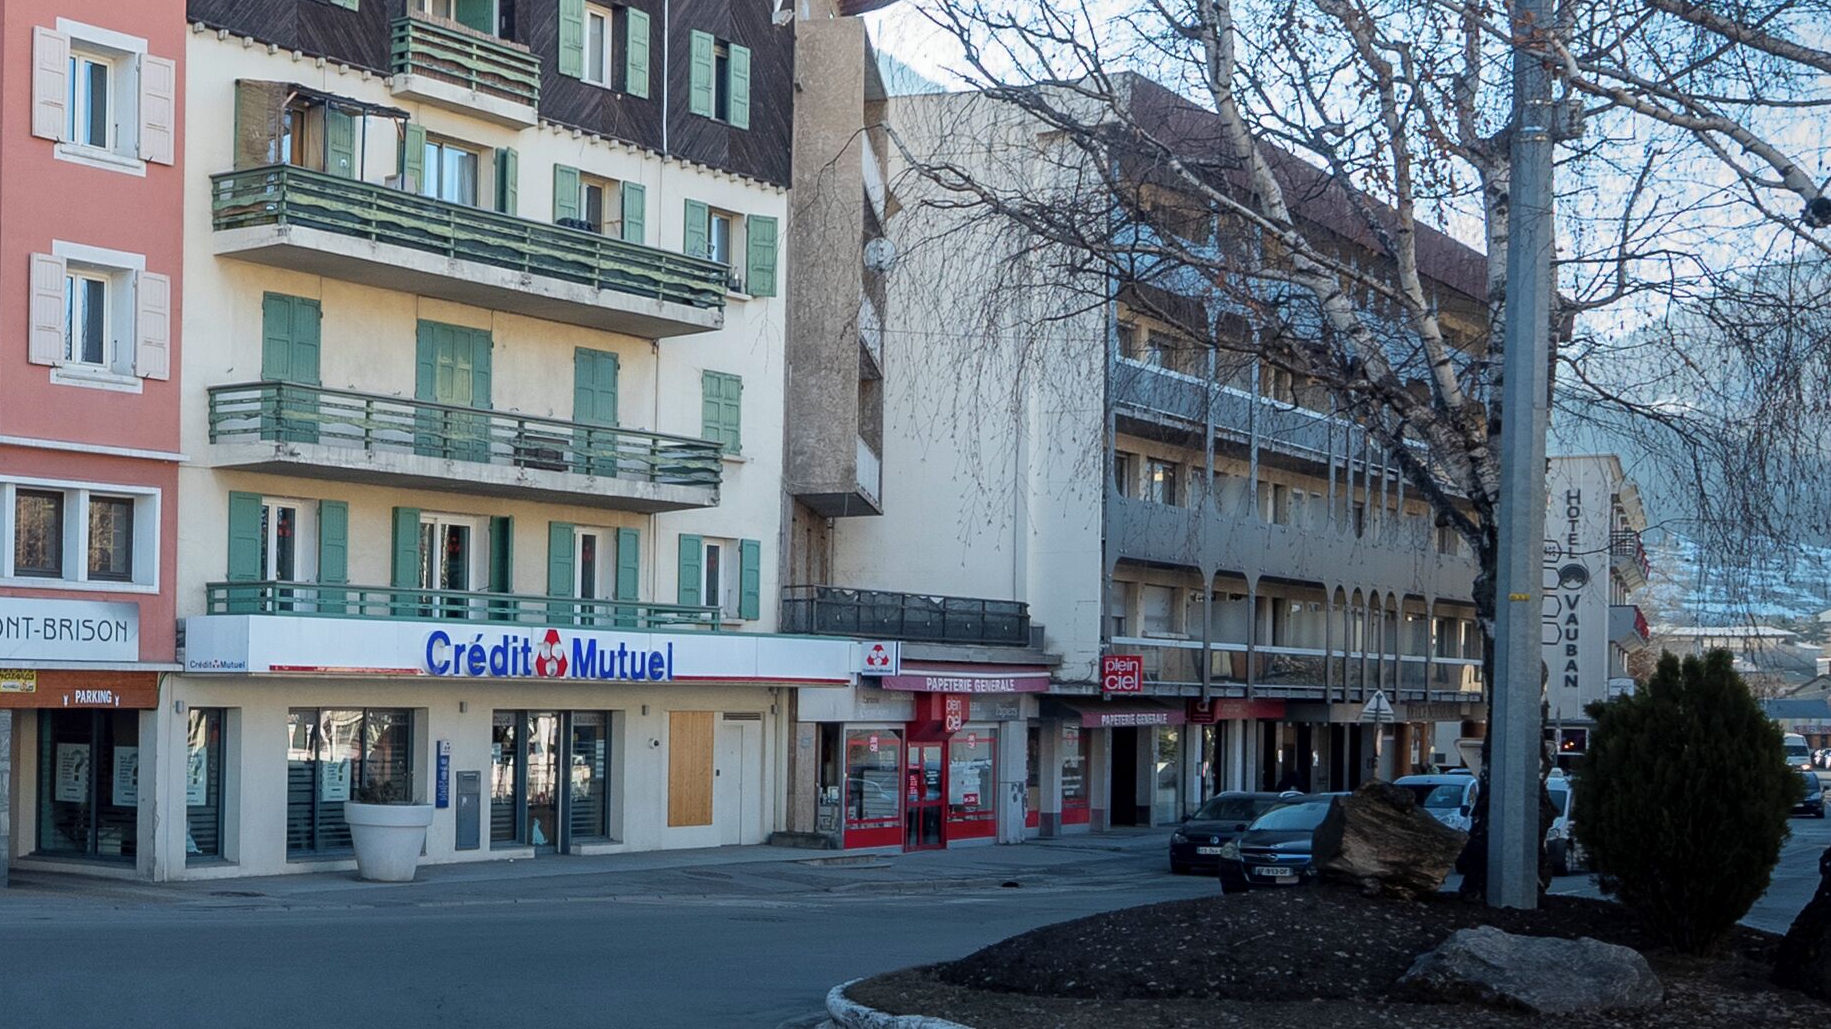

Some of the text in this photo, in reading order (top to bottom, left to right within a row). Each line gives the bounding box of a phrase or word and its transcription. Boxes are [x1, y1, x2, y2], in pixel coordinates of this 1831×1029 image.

[1566, 489, 1581, 559] HOTEL
[1564, 594, 1580, 688] VAUBAN
[426, 630, 673, 681] Crédit Mutuel
[190, 660, 246, 669] Crédit Mutuel
[1105, 658, 1139, 674] plein
[926, 677, 1015, 693] PAPETERIE GENERALE
[1104, 671, 1139, 690] ciel
[75, 690, 112, 704] PARKING
